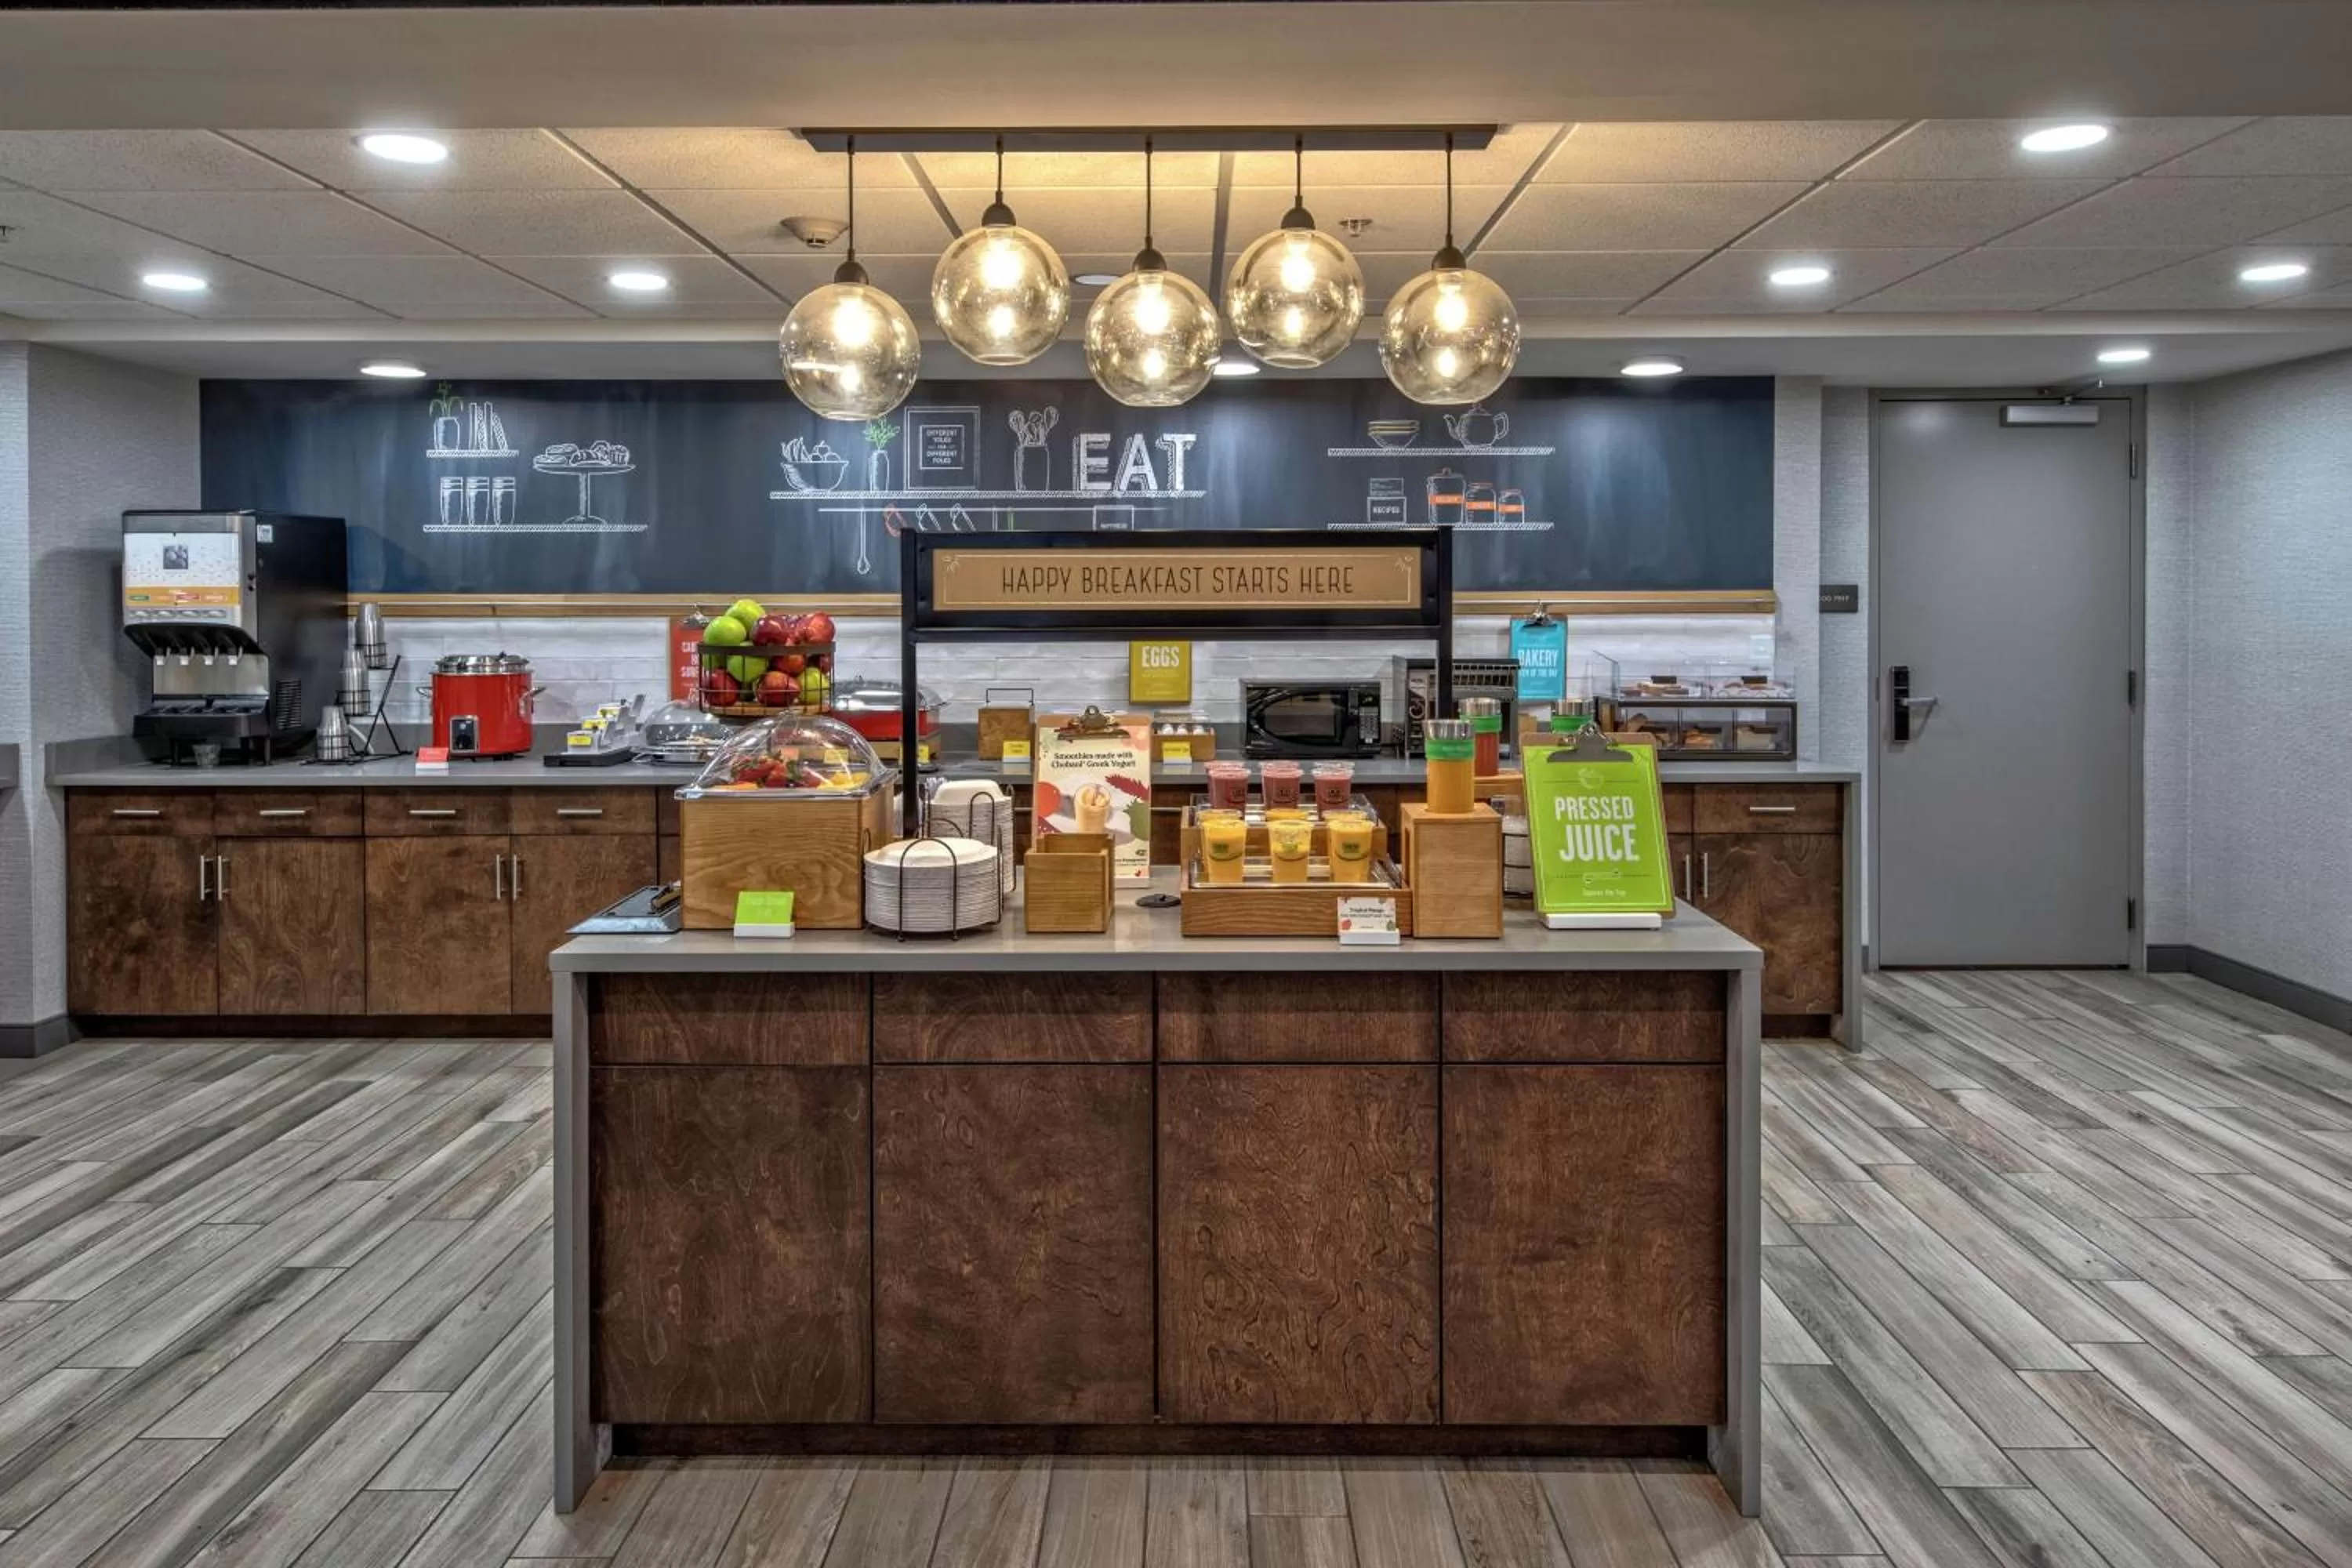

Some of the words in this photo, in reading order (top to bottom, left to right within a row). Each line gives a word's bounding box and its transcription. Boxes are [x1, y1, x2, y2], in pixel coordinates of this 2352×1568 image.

[1073, 433, 1197, 491] EAT
[1003, 567, 1071, 593] HAPPY
[1082, 567, 1203, 593] BREAKFAST
[1213, 567, 1288, 593] STARTS
[1300, 567, 1354, 593] HERE
[1142, 646, 1180, 667] EGGS
[1518, 649, 1559, 667] BAKERY
[1555, 796, 1635, 822] PRESSED
[1559, 824, 1640, 862] JUICE
